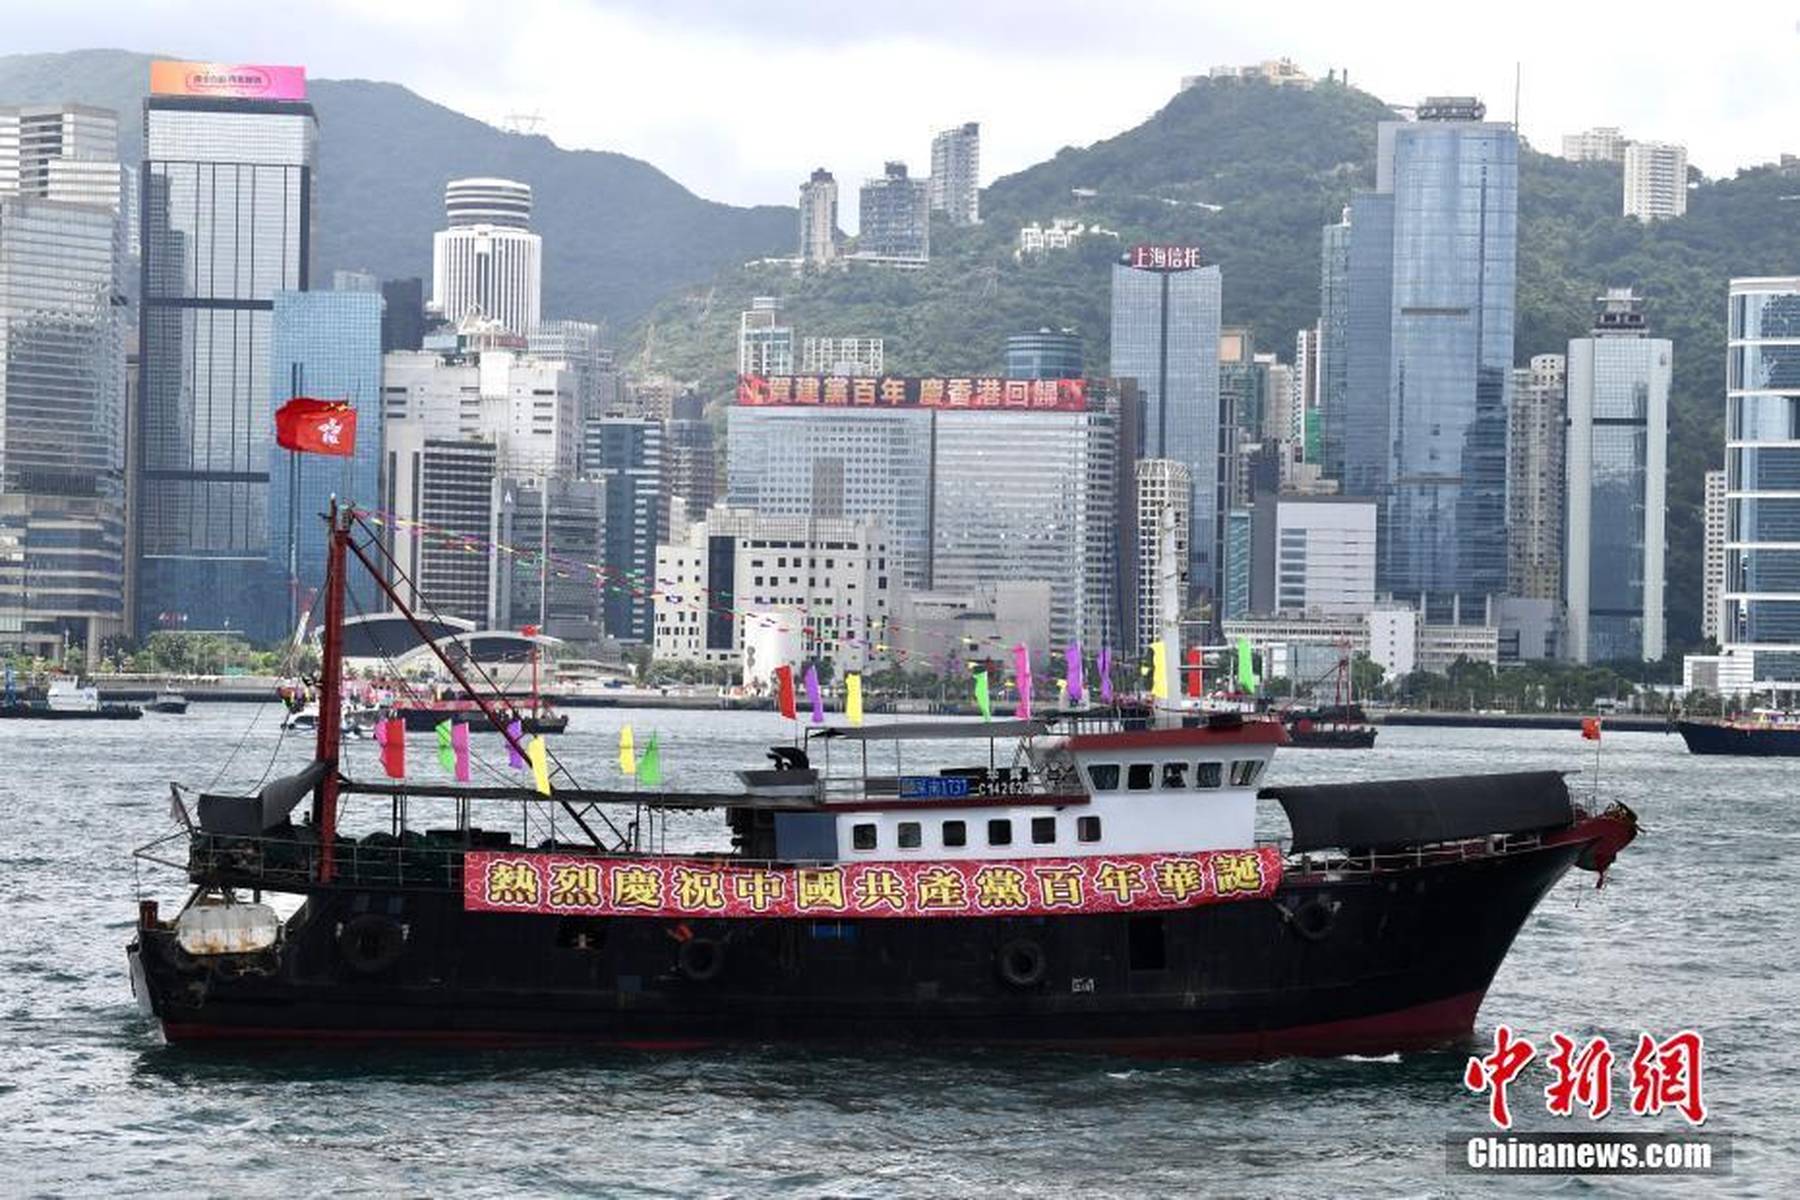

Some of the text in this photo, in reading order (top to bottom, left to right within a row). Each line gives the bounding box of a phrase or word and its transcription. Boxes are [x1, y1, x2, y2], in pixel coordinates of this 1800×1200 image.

[1132, 246, 1201, 269] 上海信托
[486, 854, 1262, 910] 熱烈慶祝中國共產黨百年華誕
